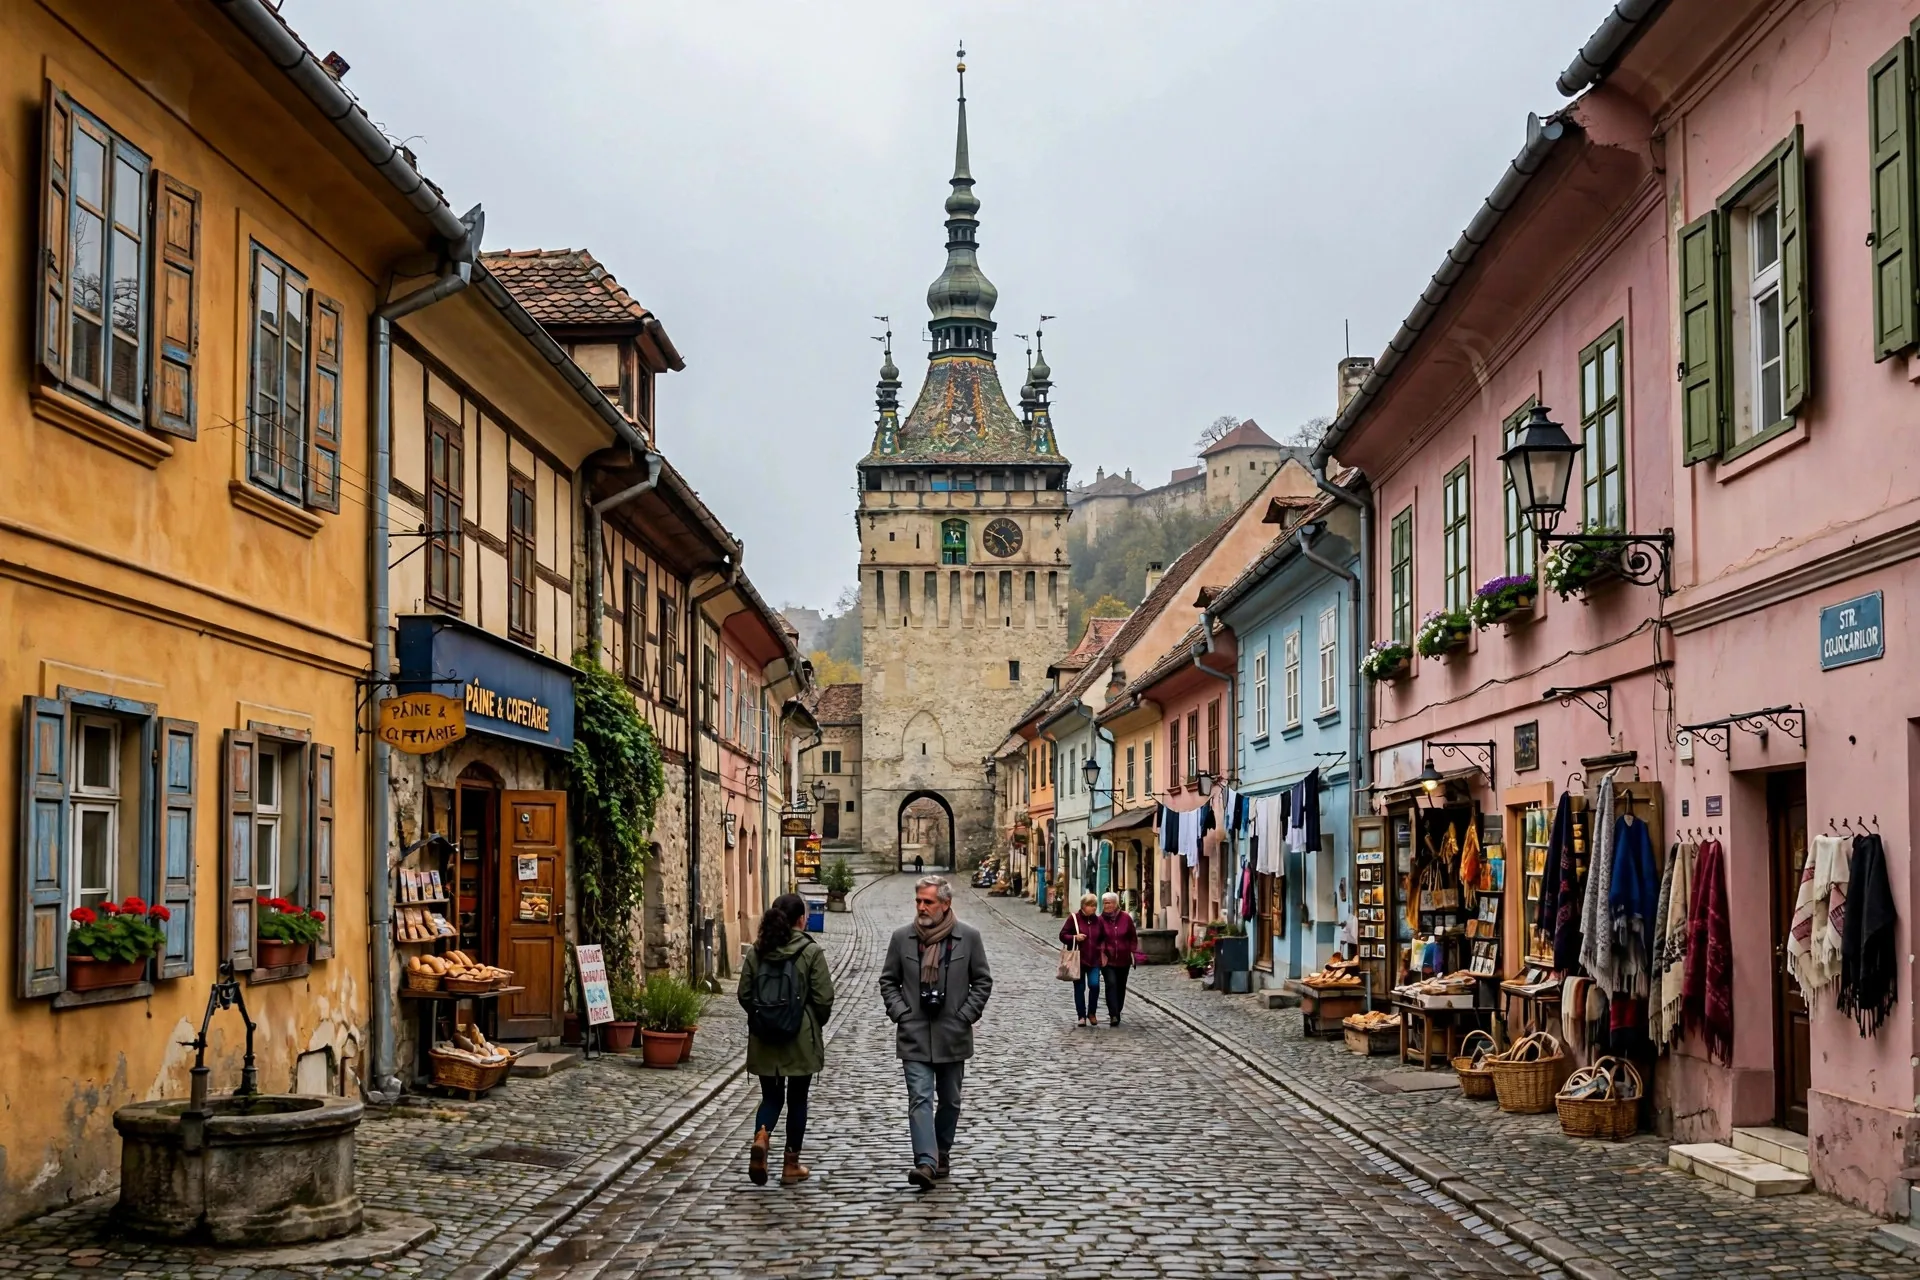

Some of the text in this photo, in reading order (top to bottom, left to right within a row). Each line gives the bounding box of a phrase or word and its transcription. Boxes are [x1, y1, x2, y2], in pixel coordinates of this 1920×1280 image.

[1840, 608, 1857, 630] STR.
[392, 701, 446, 719] PÂINE &
[466, 677, 549, 732] PÂINE & COFETĂRIE
